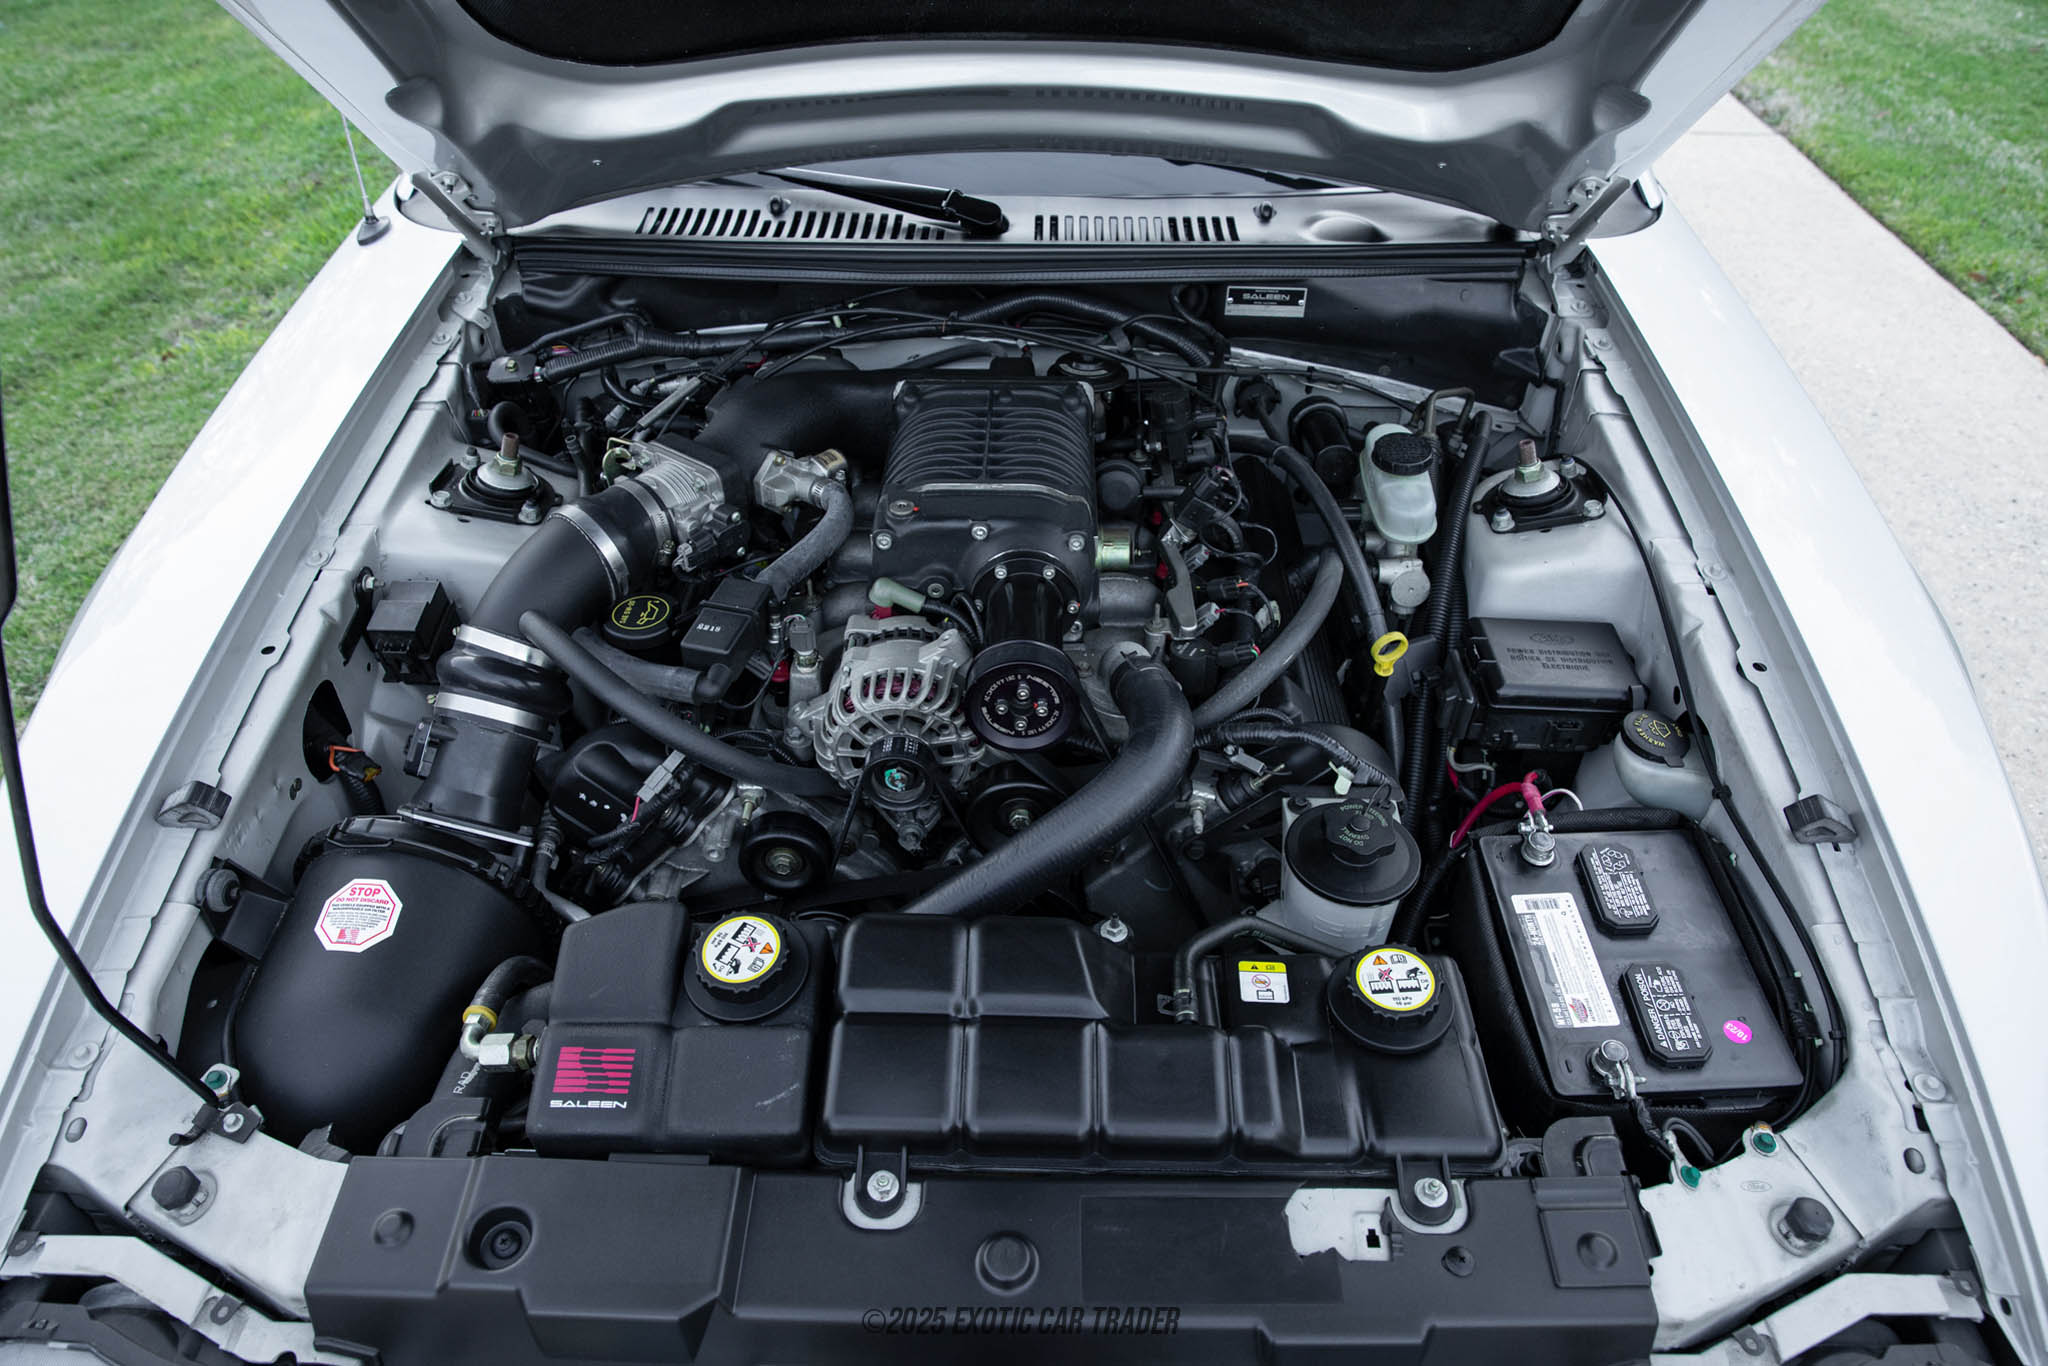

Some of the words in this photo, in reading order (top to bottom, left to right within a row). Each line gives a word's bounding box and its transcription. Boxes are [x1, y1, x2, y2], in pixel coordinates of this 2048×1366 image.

[1242, 293, 1290, 301] SALEEN
[349, 887, 381, 897] STOP
[360, 897, 389, 905] DISCARD
[1635, 973, 1651, 1001] POISON
[1648, 1008, 1666, 1041] DANGER
[1725, 1023, 1748, 1041] 10/23
[549, 1100, 627, 1109] SALEEN
